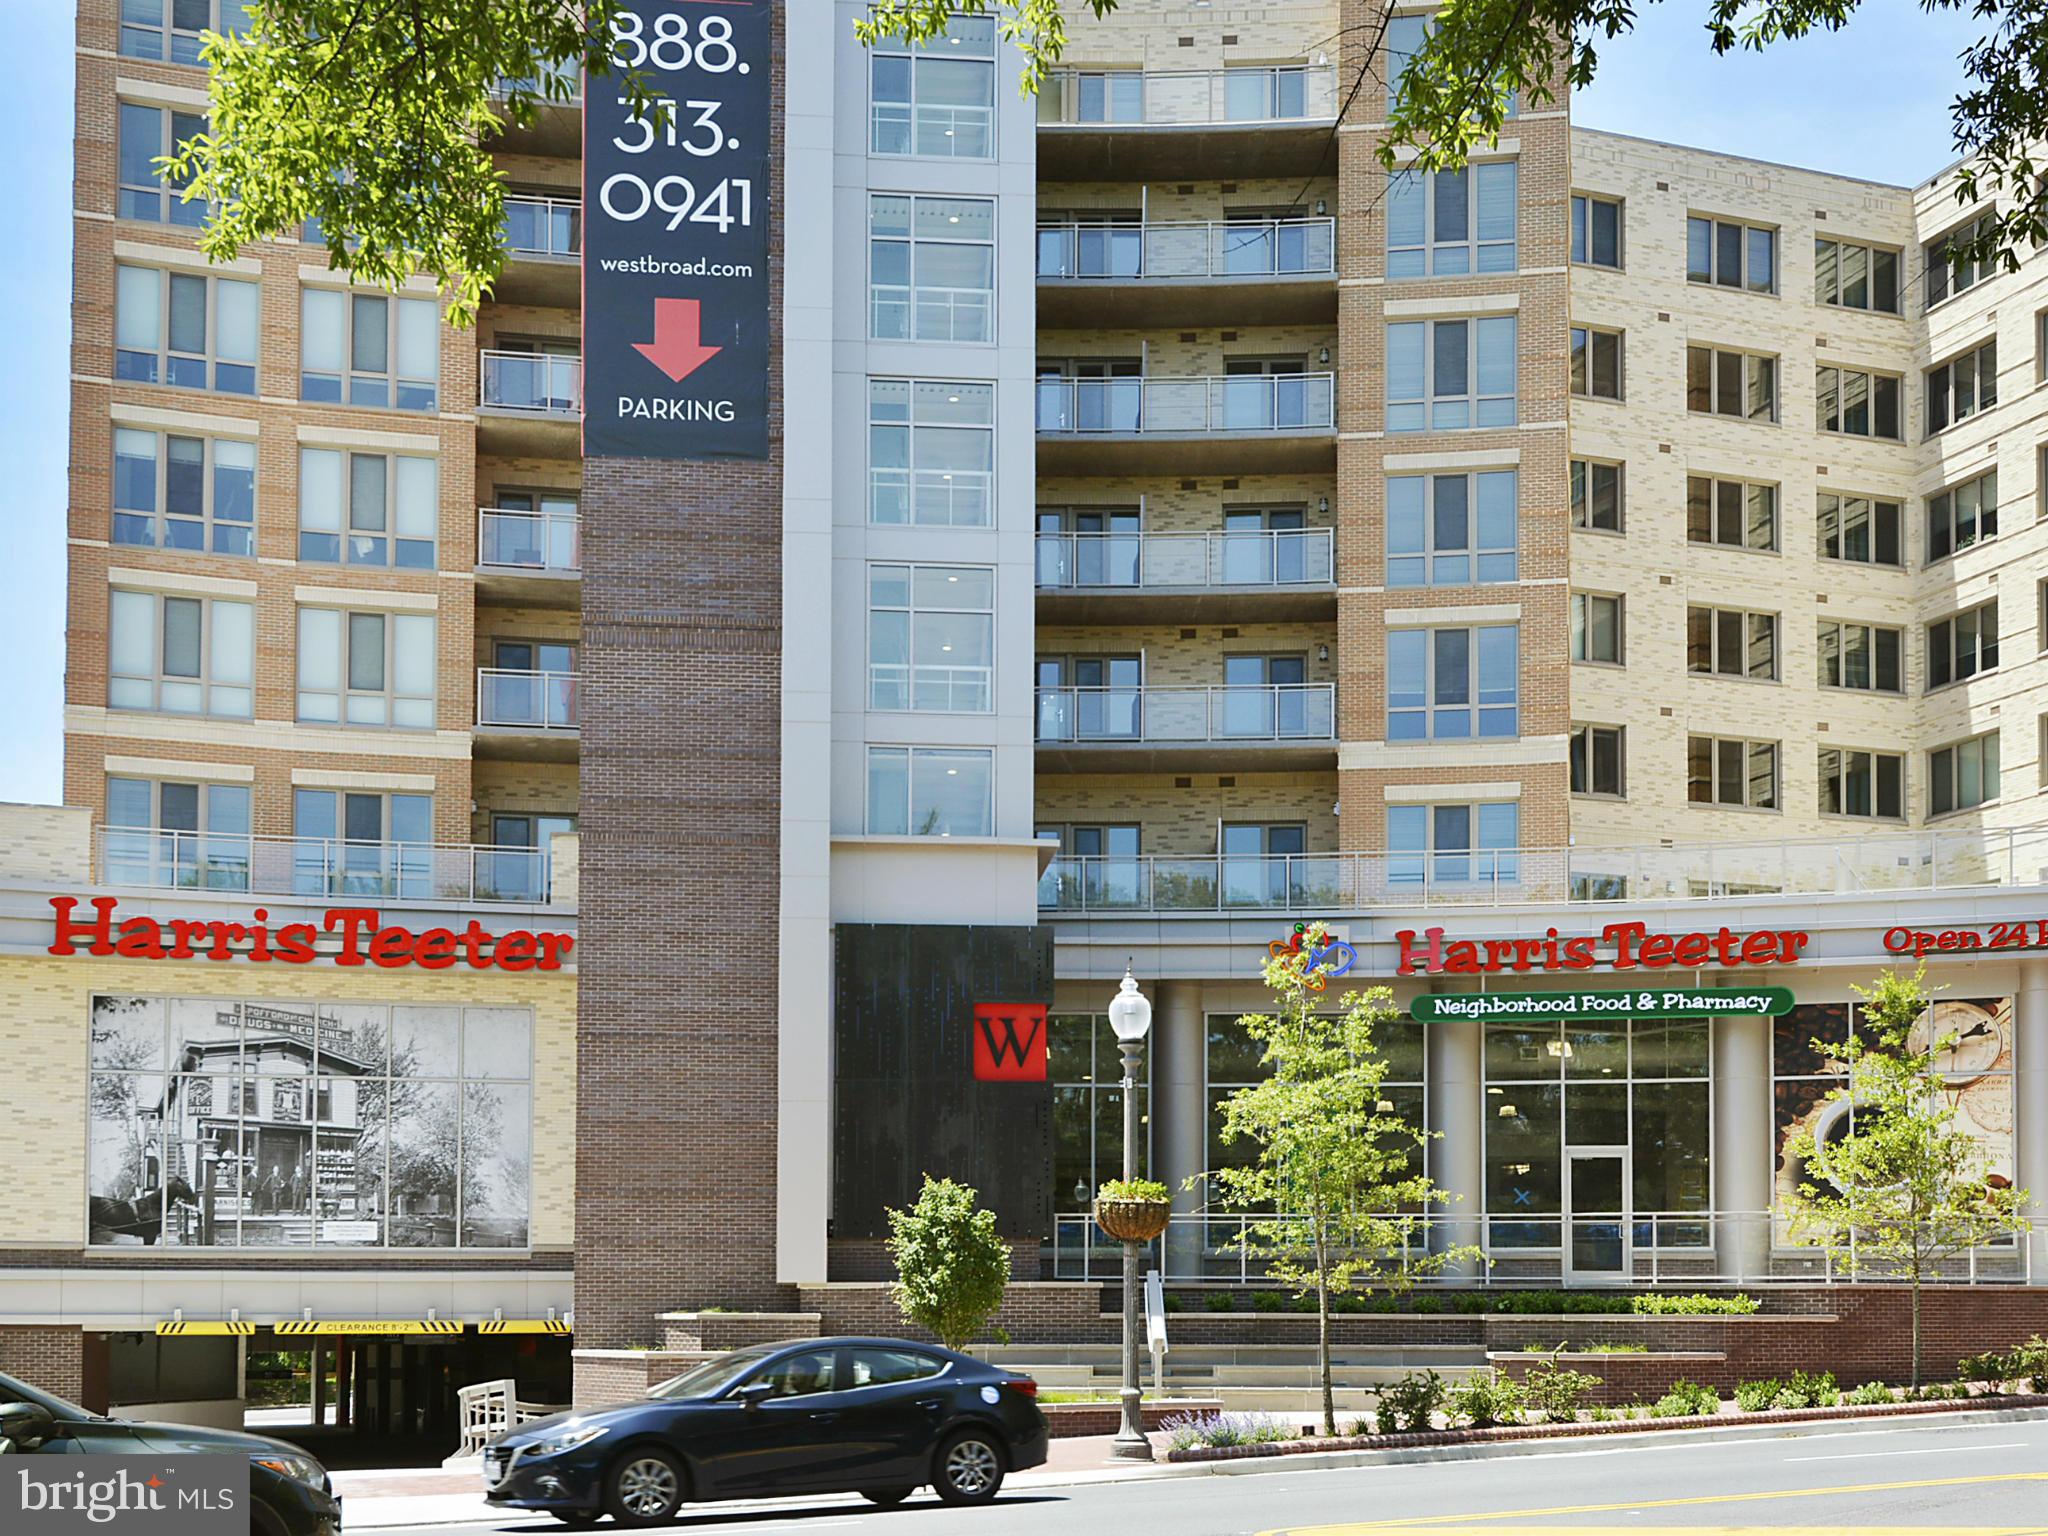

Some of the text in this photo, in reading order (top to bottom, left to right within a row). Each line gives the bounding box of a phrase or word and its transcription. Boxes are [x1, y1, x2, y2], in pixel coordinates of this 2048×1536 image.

[605, 11, 750, 74] 888.
[612, 97, 740, 157] 313.
[599, 173, 752, 234] 0941
[600, 256, 753, 278] westbroad.com
[618, 396, 735, 422] PARKING
[48, 896, 574, 972] Harris Teeter
[1395, 920, 1809, 976] Harris Teeter
[1883, 926, 1983, 958] Open
[1988, 922, 2029, 948] 24
[1433, 992, 1773, 1018] Neighborhood Food & Pharmacy
[228, 1016, 343, 1040] DUGS MEDCINE
[976, 1017, 1043, 1068] W
[326, 1323, 388, 1332] CLEARANCE
